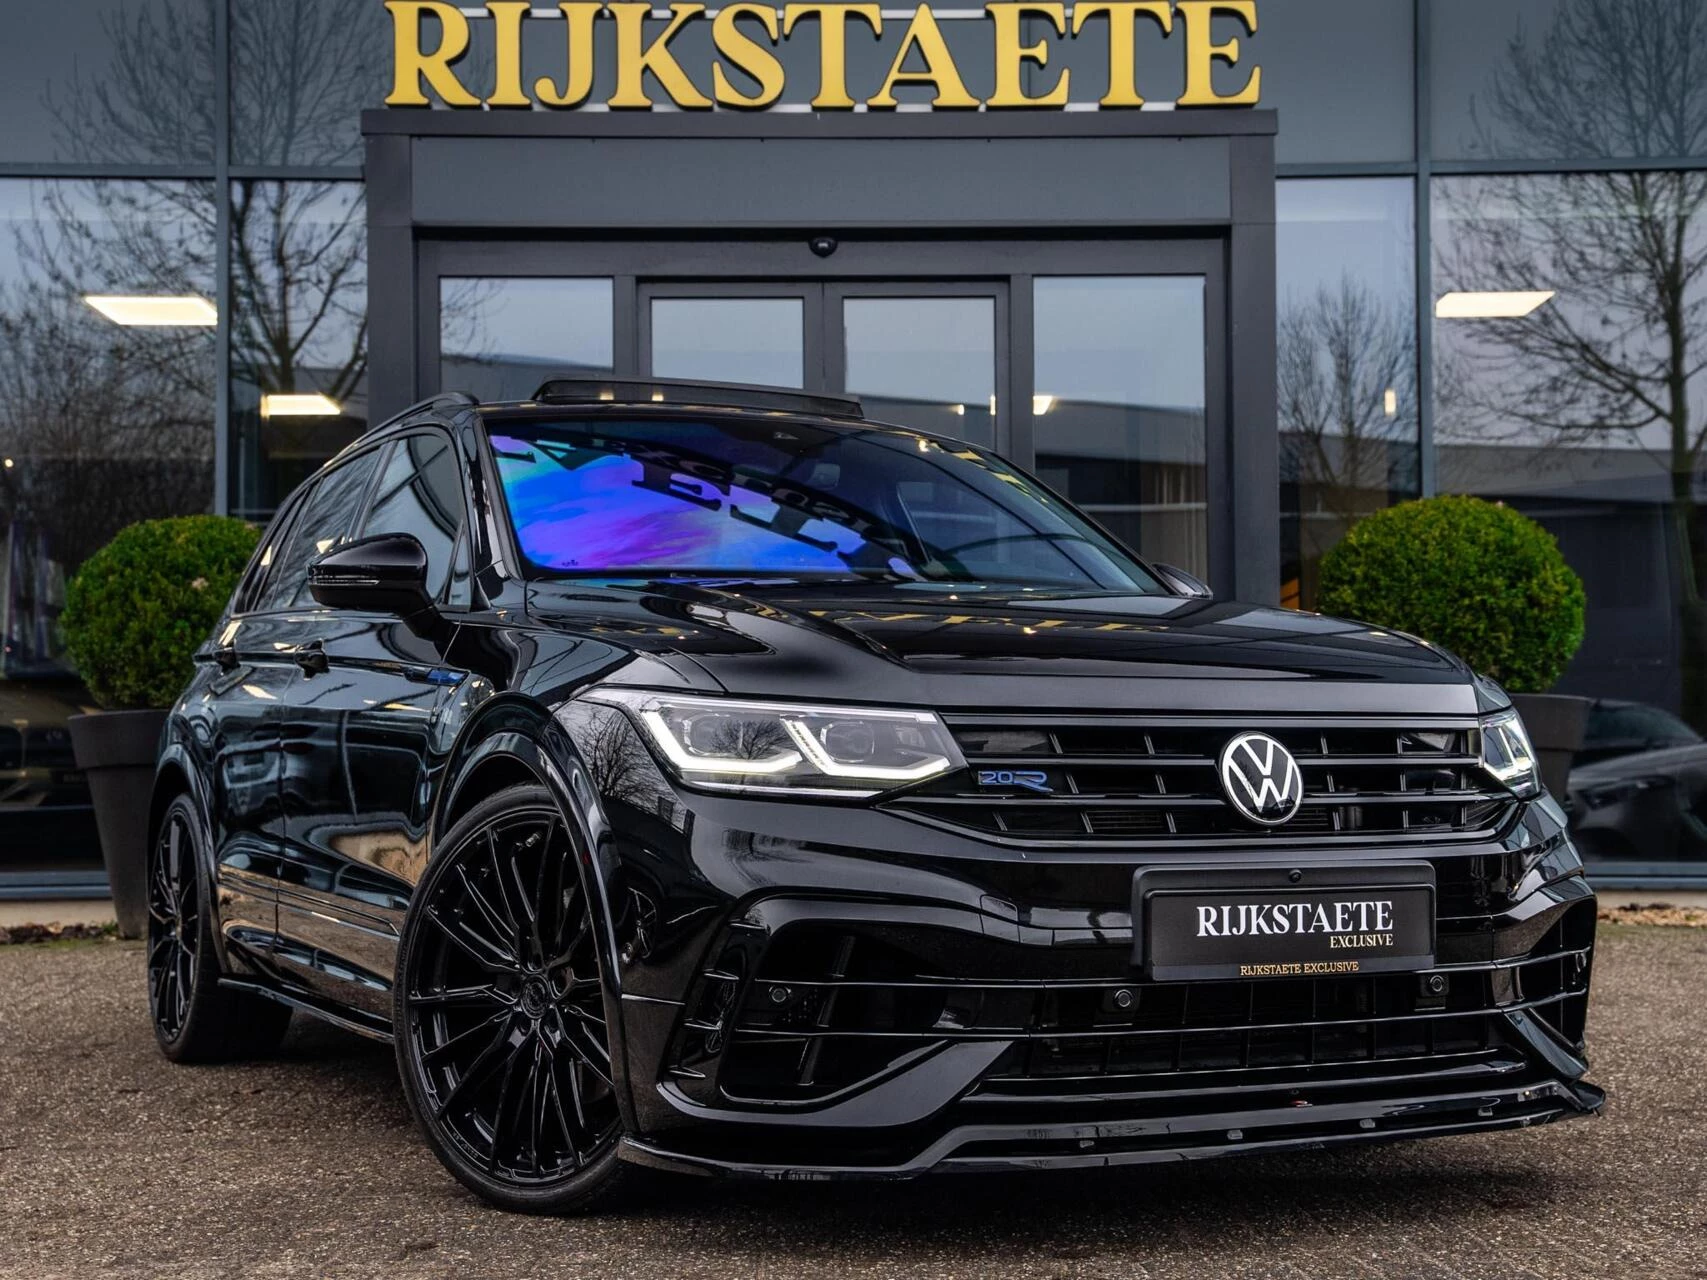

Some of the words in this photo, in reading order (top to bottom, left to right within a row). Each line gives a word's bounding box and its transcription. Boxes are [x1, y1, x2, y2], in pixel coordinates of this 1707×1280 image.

[385, 0, 1262, 110] RIJKSTAETE
[1196, 902, 1393, 937] RIJKSTAETE
[1330, 934, 1393, 949] EXCLUSIVE
[1240, 963, 1301, 976] RIJKSTAETE
[1304, 962, 1360, 974] EXCLUSIVE
